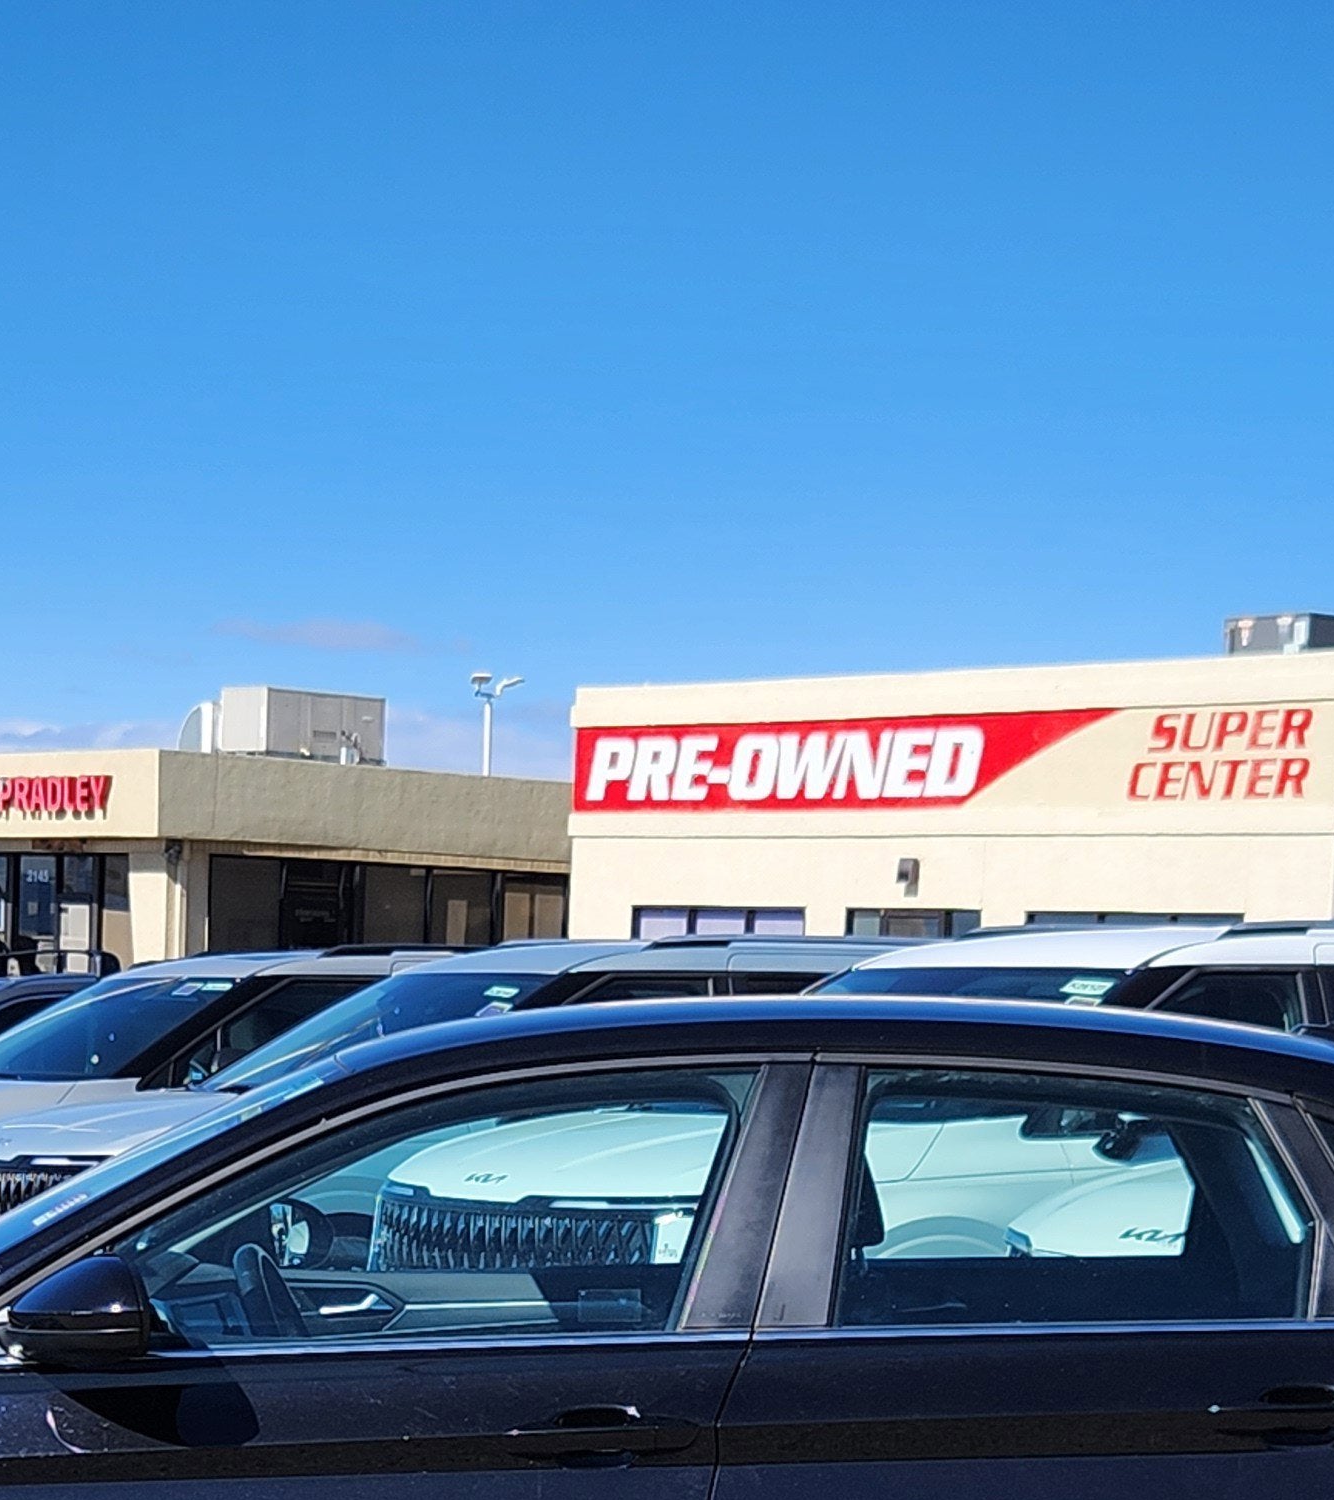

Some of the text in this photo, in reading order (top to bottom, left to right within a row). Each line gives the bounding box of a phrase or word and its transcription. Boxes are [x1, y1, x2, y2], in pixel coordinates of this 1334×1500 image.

[1148, 708, 1313, 753] SUPER
[585, 726, 985, 801] PRE-OWNED
[1127, 758, 1311, 801] CENTER
